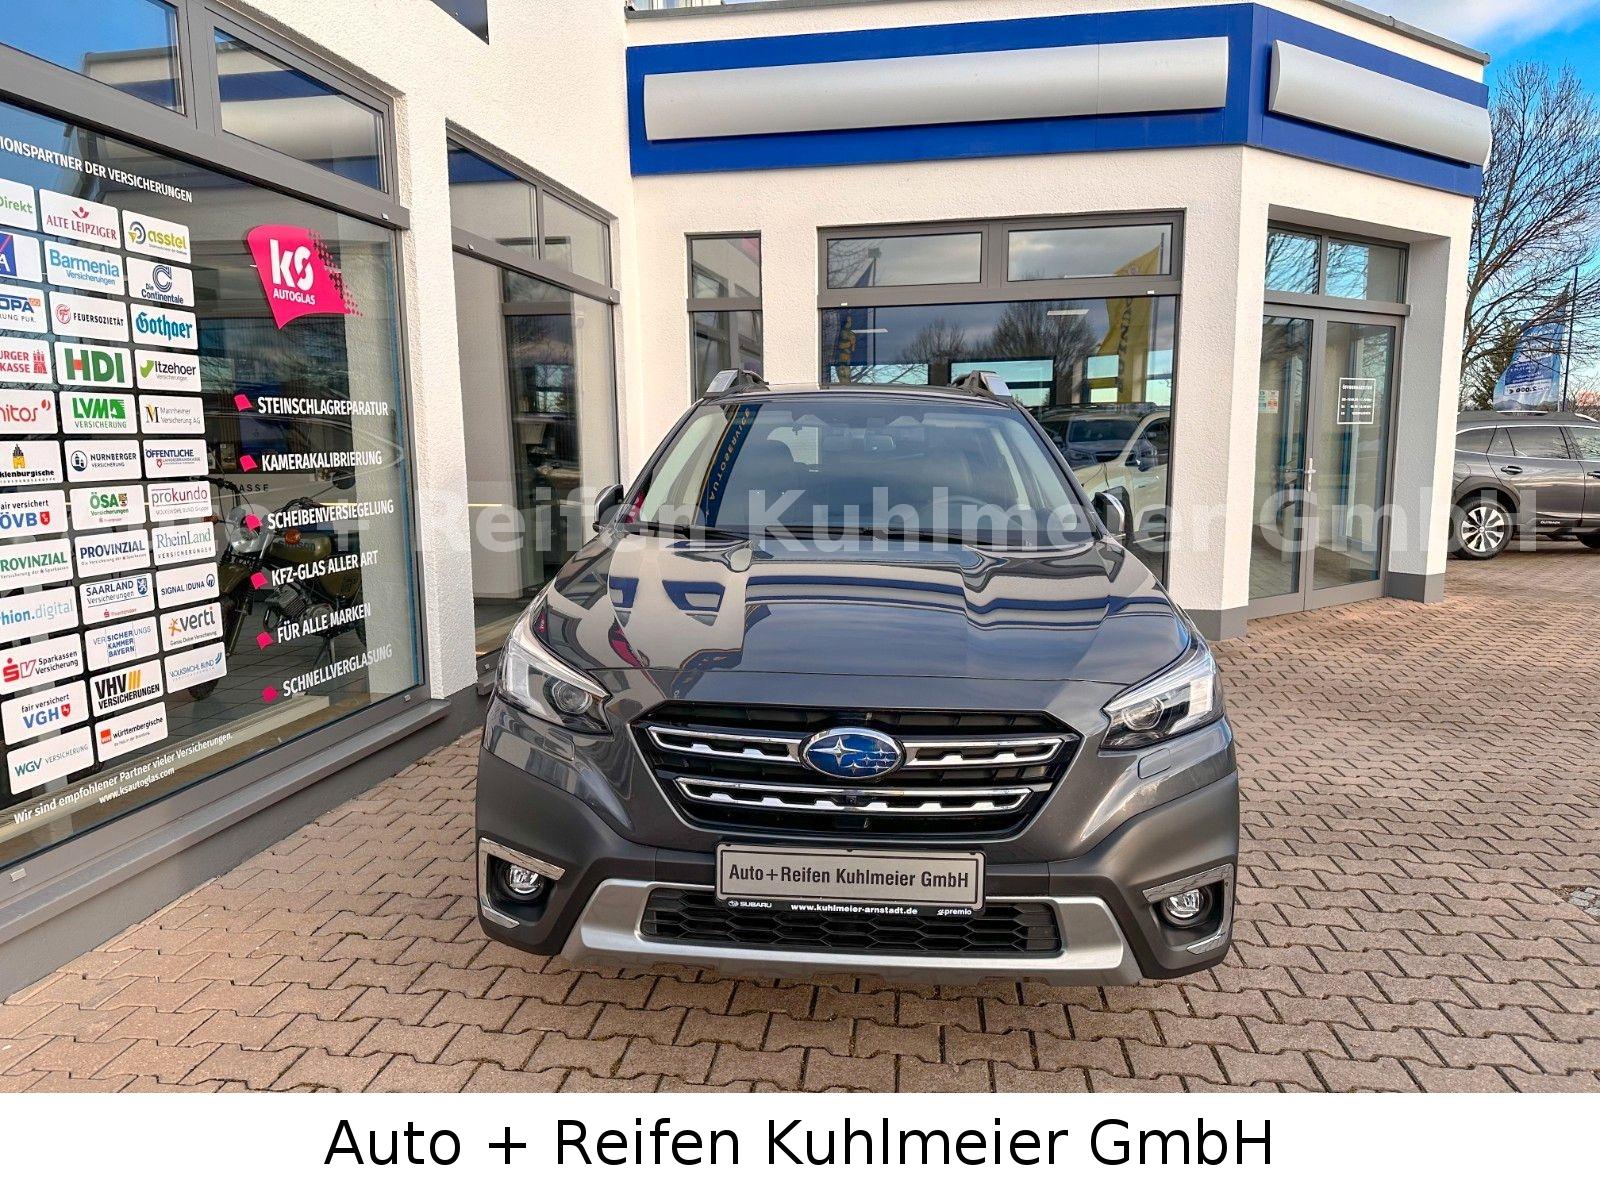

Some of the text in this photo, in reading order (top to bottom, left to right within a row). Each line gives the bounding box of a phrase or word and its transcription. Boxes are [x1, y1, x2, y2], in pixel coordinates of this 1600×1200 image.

[84, 161, 107, 178] DER
[108, 168, 193, 203] VERSICHERUNGEN
[46, 214, 117, 241] ALTE LEIPZIGER
[147, 230, 188, 250] asstel
[49, 248, 120, 278] Barmenia
[67, 271, 116, 286] Versicherungen
[141, 288, 184, 304] Continentale
[273, 288, 316, 305] AUTOGLAS
[73, 312, 125, 327] FEUERSOZIETÄT
[135, 311, 193, 341] Gothaer
[64, 347, 125, 384] HDI
[154, 360, 197, 376] Itzehoer
[72, 397, 110, 419] LVM
[257, 396, 389, 416] STEINSCHLAGREPARATUR
[74, 421, 127, 429] VERSICHERUNG
[90, 452, 137, 461] NÜRNBERGER
[145, 448, 195, 458] ÖFFENTLICHE
[262, 450, 382, 472] KAMERAKALIBRIERUNG
[151, 486, 208, 507] prokundo
[239, 483, 270, 494] ASSE
[12, 500, 49, 509] versichert
[90, 491, 119, 510] ÖSA
[0, 511, 38, 530] ÖVB
[90, 508, 130, 516] Versicherungen
[267, 499, 394, 530] SCHEIBENVERSIEGELUNG
[156, 527, 211, 549] RheinLand
[80, 540, 146, 560] PROVINZIAL
[157, 547, 212, 559] VERSICHERUNGEN
[0, 552, 68, 573] ROVINZIAL
[271, 550, 379, 586] KFZ-GLAS ALLER ART
[86, 580, 134, 597] SAARLAND
[87, 591, 135, 605] Versicherungen
[161, 581, 205, 596] SIGNAL IDUNA
[0, 598, 73, 626] hion.digital
[180, 606, 216, 632] verti
[277, 602, 371, 644] FÜR ALLE MARKEN
[93, 626, 152, 645] VERSICHERUNGS
[107, 638, 134, 649] KAMMER
[39, 651, 78, 666] Sparkassen
[108, 645, 135, 658] BAYERN
[35, 659, 79, 675] Versicherung
[283, 643, 393, 698] SCHNELLVERGLASUNG
[95, 674, 127, 700] VHV
[98, 683, 160, 710] VERSICHERUNGEN
[21, 693, 70, 713] fair versichert
[23, 707, 59, 729] VGH
[113, 717, 164, 739] württembergische
[14, 743, 89, 777] WGV VERSICHERUNG
[13, 732, 233, 825] Wir sind empfohlener Partner vieler Versicherungen.
[98, 766, 175, 804] www.ksautoglas.com
[836, 868, 916, 887] Kuhlmeier
[921, 871, 969, 888] GmbH
[790, 903, 918, 915] www.kuhlmeier-arnstadt.de
[944, 908, 972, 916] premio
